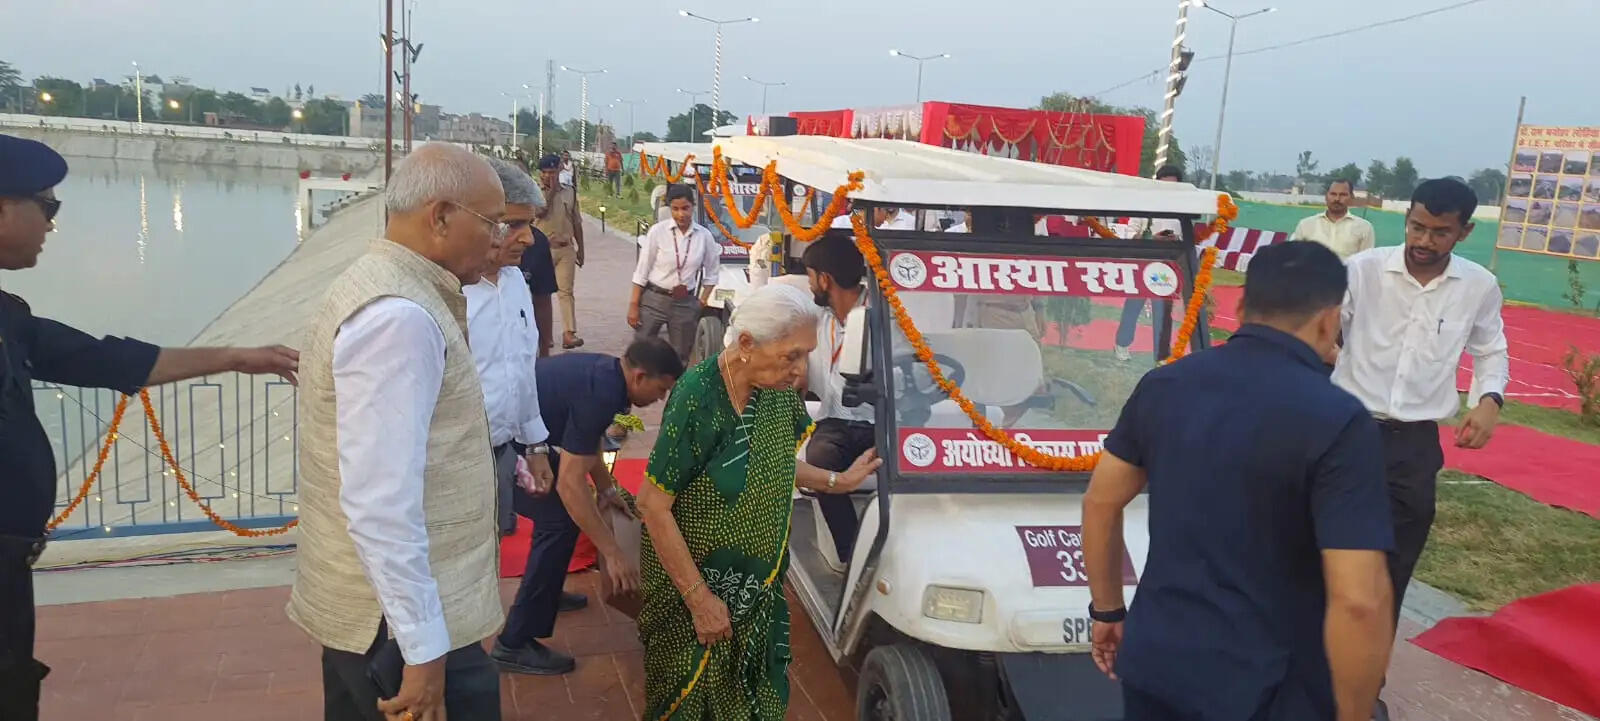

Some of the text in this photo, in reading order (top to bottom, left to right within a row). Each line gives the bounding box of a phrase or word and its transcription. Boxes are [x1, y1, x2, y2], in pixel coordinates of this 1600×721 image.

[931, 255, 1139, 294] आस्था रथ
[941, 432, 1013, 468] अयोध्या
[1024, 529, 1057, 548] Golf
